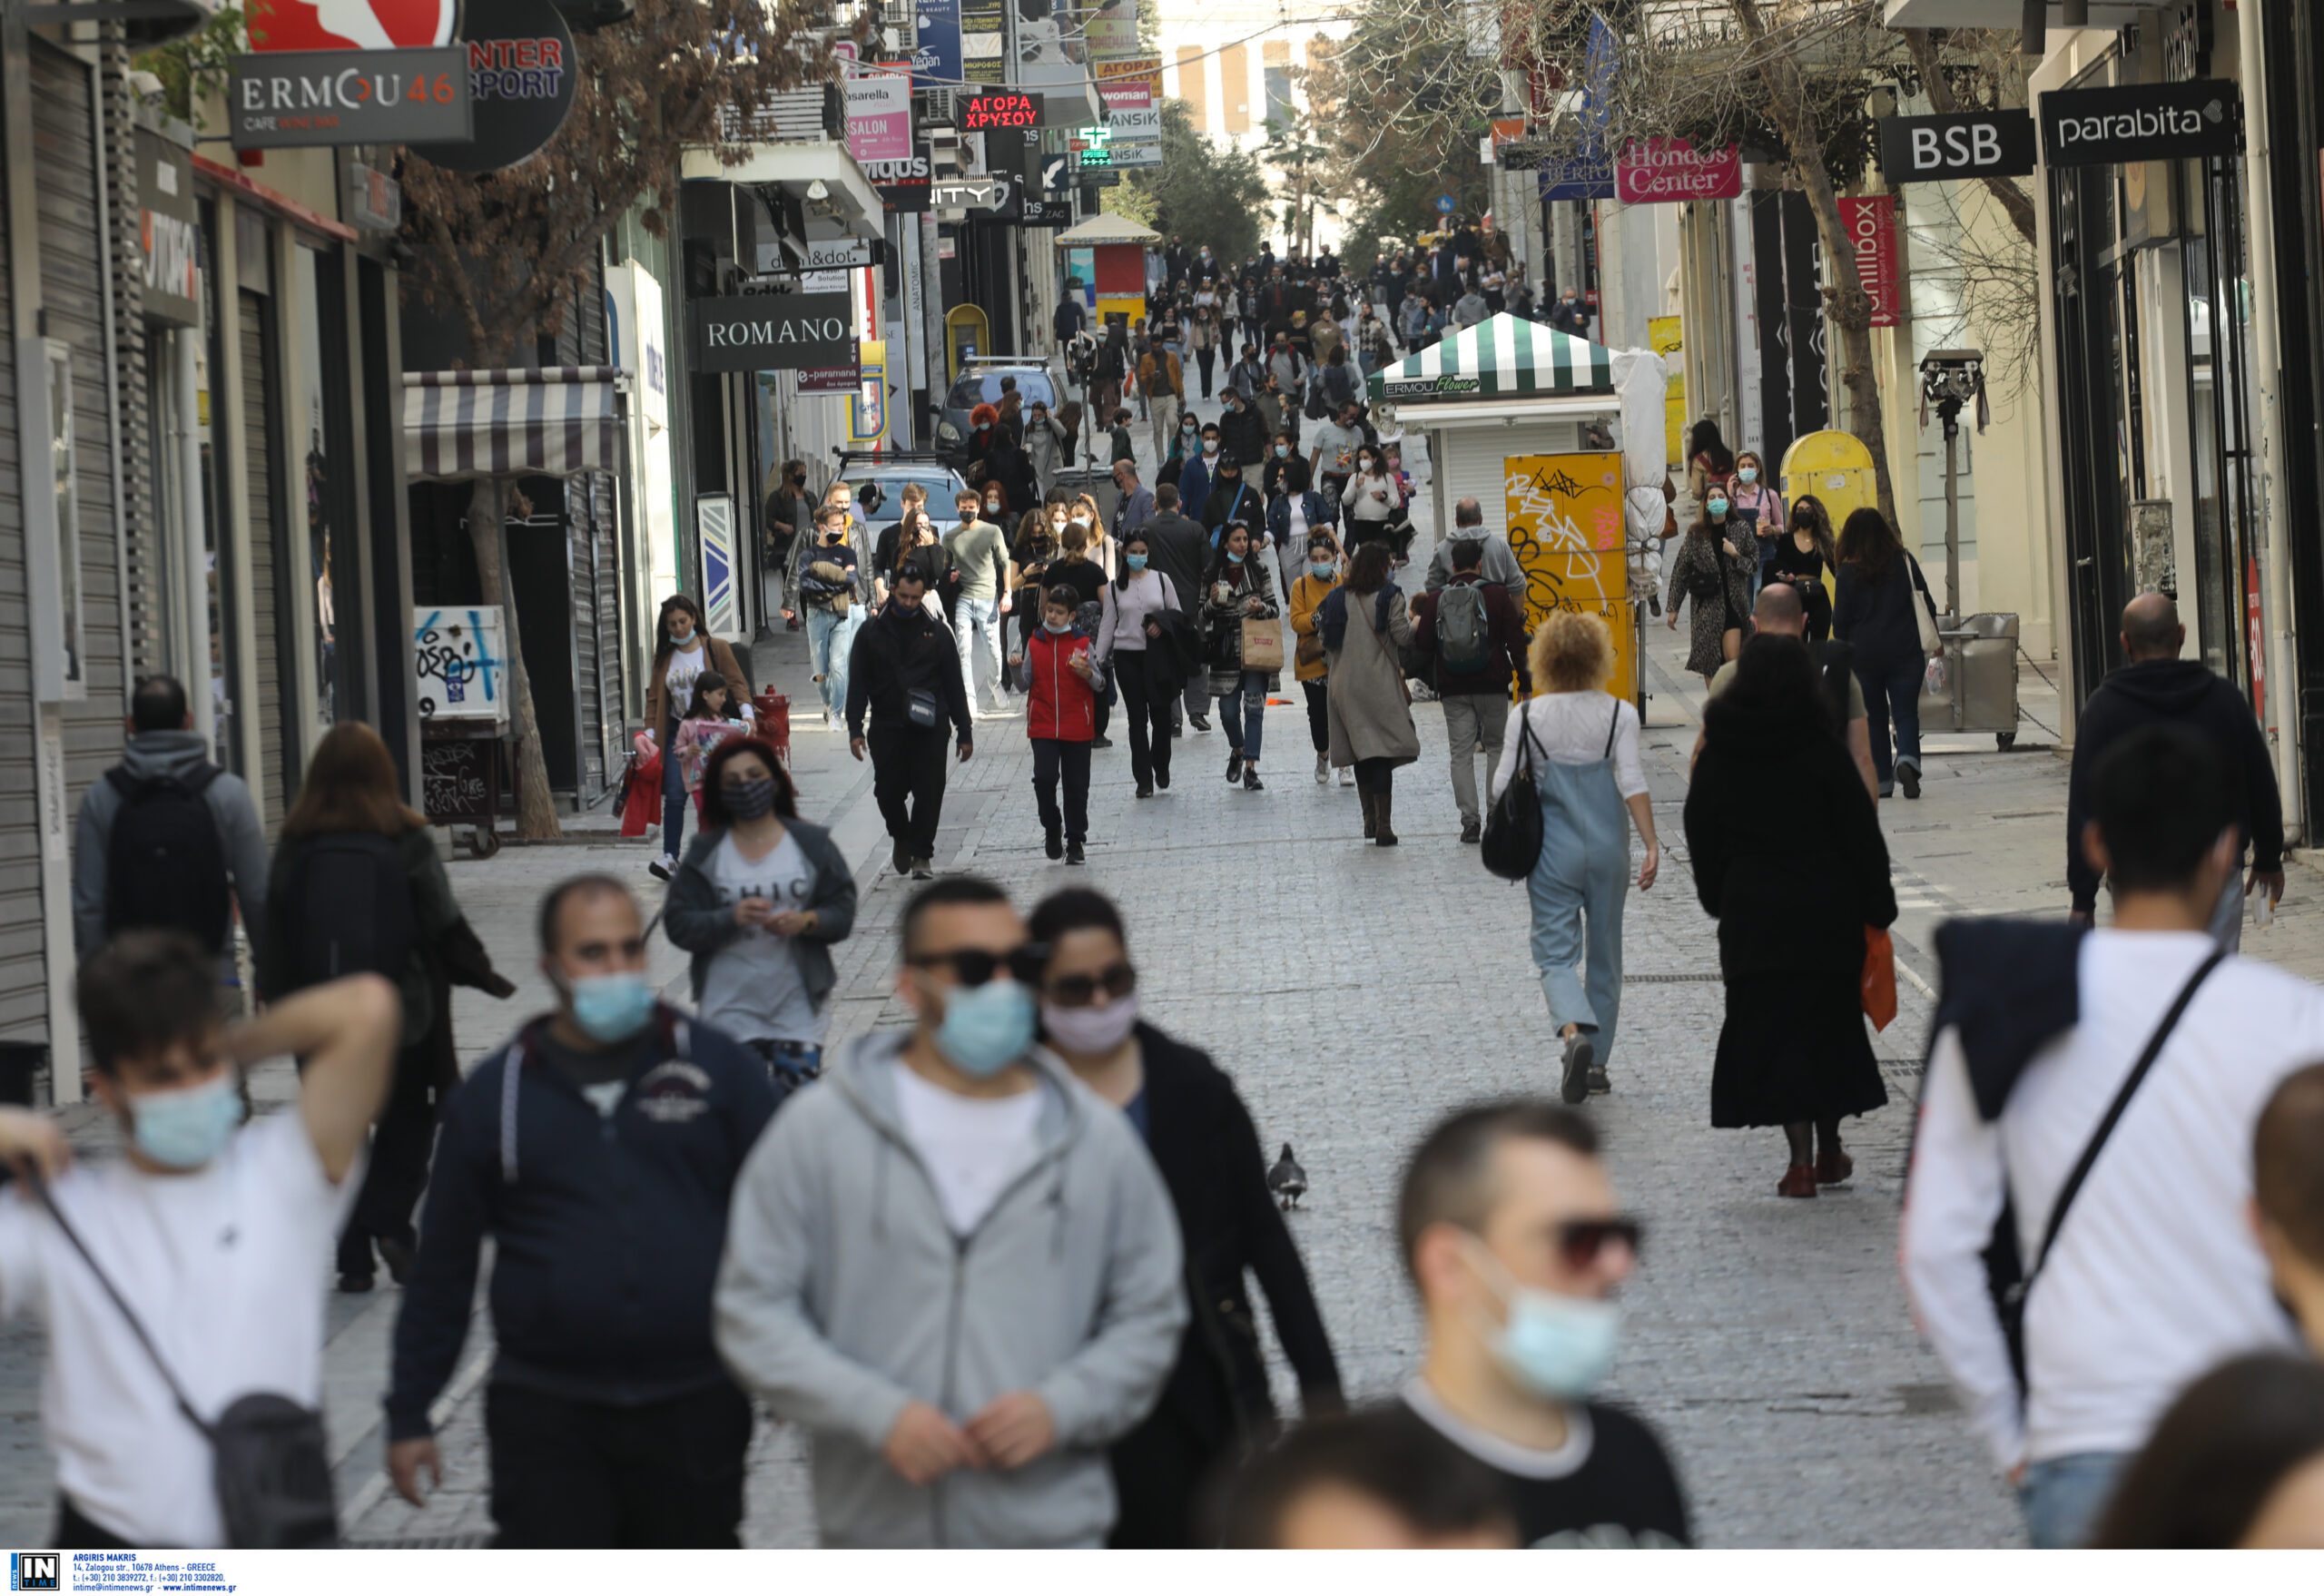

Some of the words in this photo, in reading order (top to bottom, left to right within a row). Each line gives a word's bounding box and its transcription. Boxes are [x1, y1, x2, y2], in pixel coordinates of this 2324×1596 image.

[469, 38, 563, 70] NTER
[1103, 61, 1154, 74] ΑΓΟΡΑ
[406, 73, 455, 105] 46
[847, 89, 890, 101] asarella
[1101, 91, 1149, 102] woman
[969, 95, 1032, 113] ΑΓΟΡΑ
[243, 116, 278, 132] CAFE
[278, 114, 312, 130] WINE
[313, 113, 340, 129] BAR
[850, 119, 888, 135] SALON
[966, 110, 1038, 128] ΧΡΥΣΟΥ
[2058, 105, 2202, 148] parabita
[1628, 143, 1729, 169] Hondos
[1911, 123, 2003, 171] BSB
[1628, 167, 1722, 194] Center
[1046, 210, 1065, 219] ZAC
[912, 260, 921, 310] ANATOMIC
[706, 317, 844, 347] ROMANO
[1385, 381, 1433, 395] ERMOU
[1435, 376, 1479, 391] Flower
